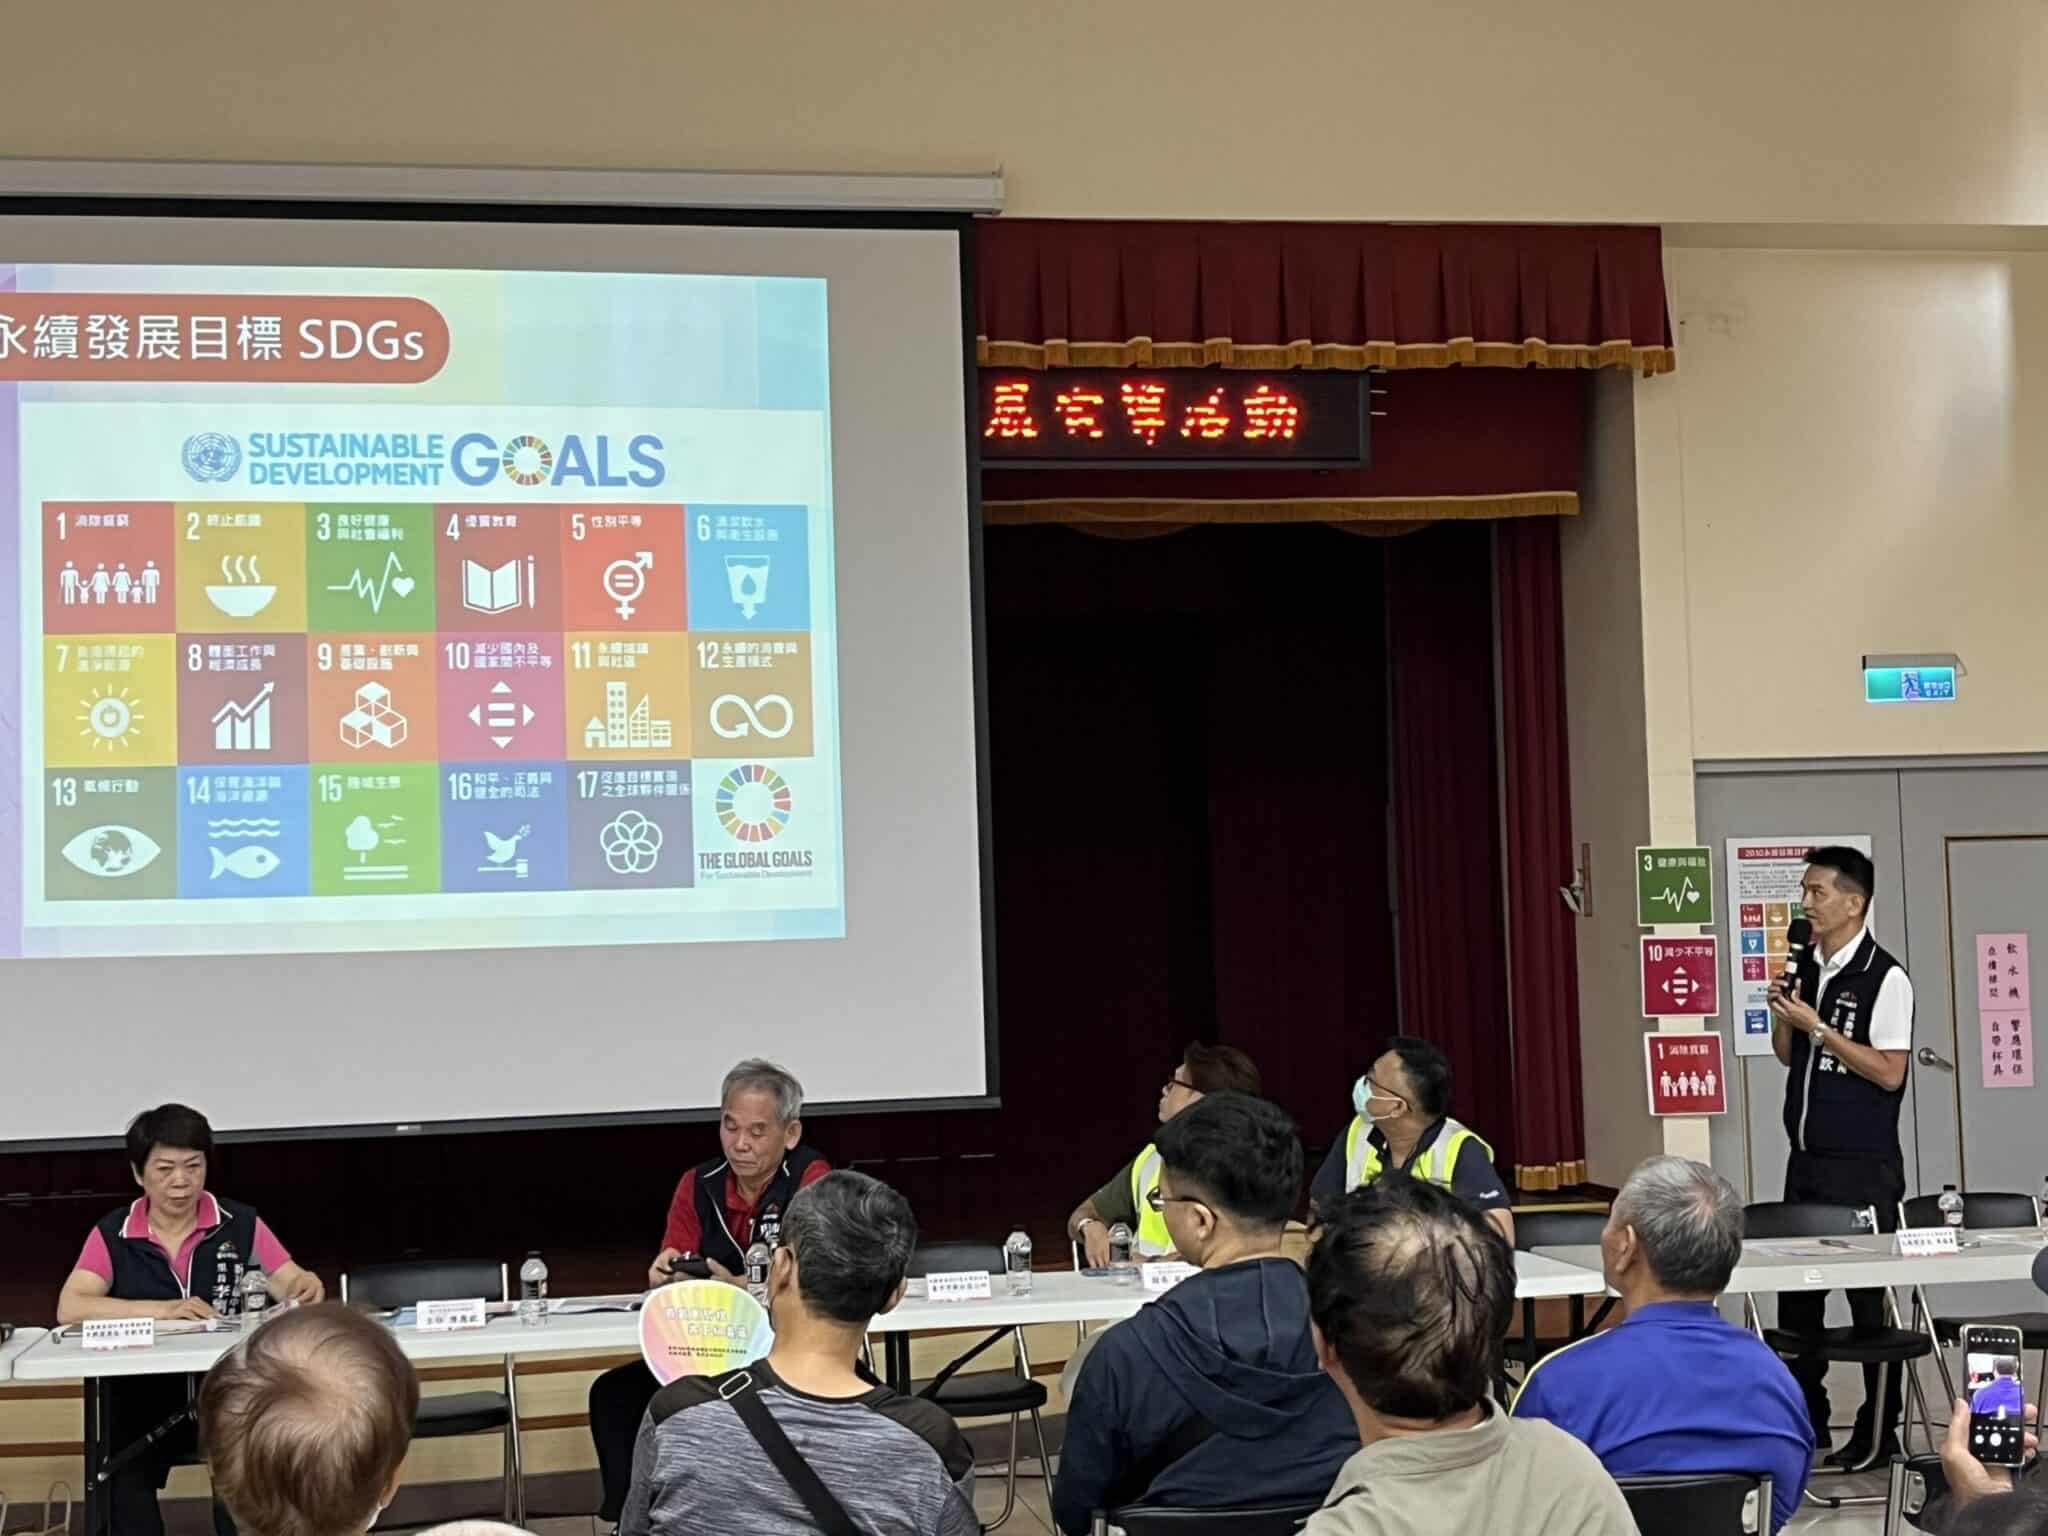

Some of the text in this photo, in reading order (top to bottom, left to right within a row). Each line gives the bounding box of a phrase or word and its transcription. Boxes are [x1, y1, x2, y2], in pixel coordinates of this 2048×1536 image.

[0, 314, 425, 361] 永續發展目標 SDGs
[248, 432, 666, 488] SUSTAINABLE GOALS
[250, 463, 444, 486] DEVELOPMENT
[56, 513, 67, 540] 1
[186, 513, 201, 541] 2
[316, 513, 331, 541] 3
[446, 514, 461, 541] 4
[571, 514, 586, 541] 5
[697, 515, 711, 541] 6
[56, 645, 69, 672] 7
[188, 643, 202, 671] 8
[317, 643, 332, 671] 9
[445, 642, 470, 670] 10
[571, 642, 592, 669] 11
[697, 641, 720, 669] 12
[52, 778, 77, 806] 13
[187, 776, 211, 804] 14
[318, 775, 342, 803] 15
[448, 773, 472, 800] 16
[577, 771, 598, 798] 17
[698, 850, 812, 869] THE GLOBAL GOALS
[1643, 855, 1653, 871] 3
[1647, 945, 1662, 961] 10
[1657, 1043, 1664, 1060] 1
